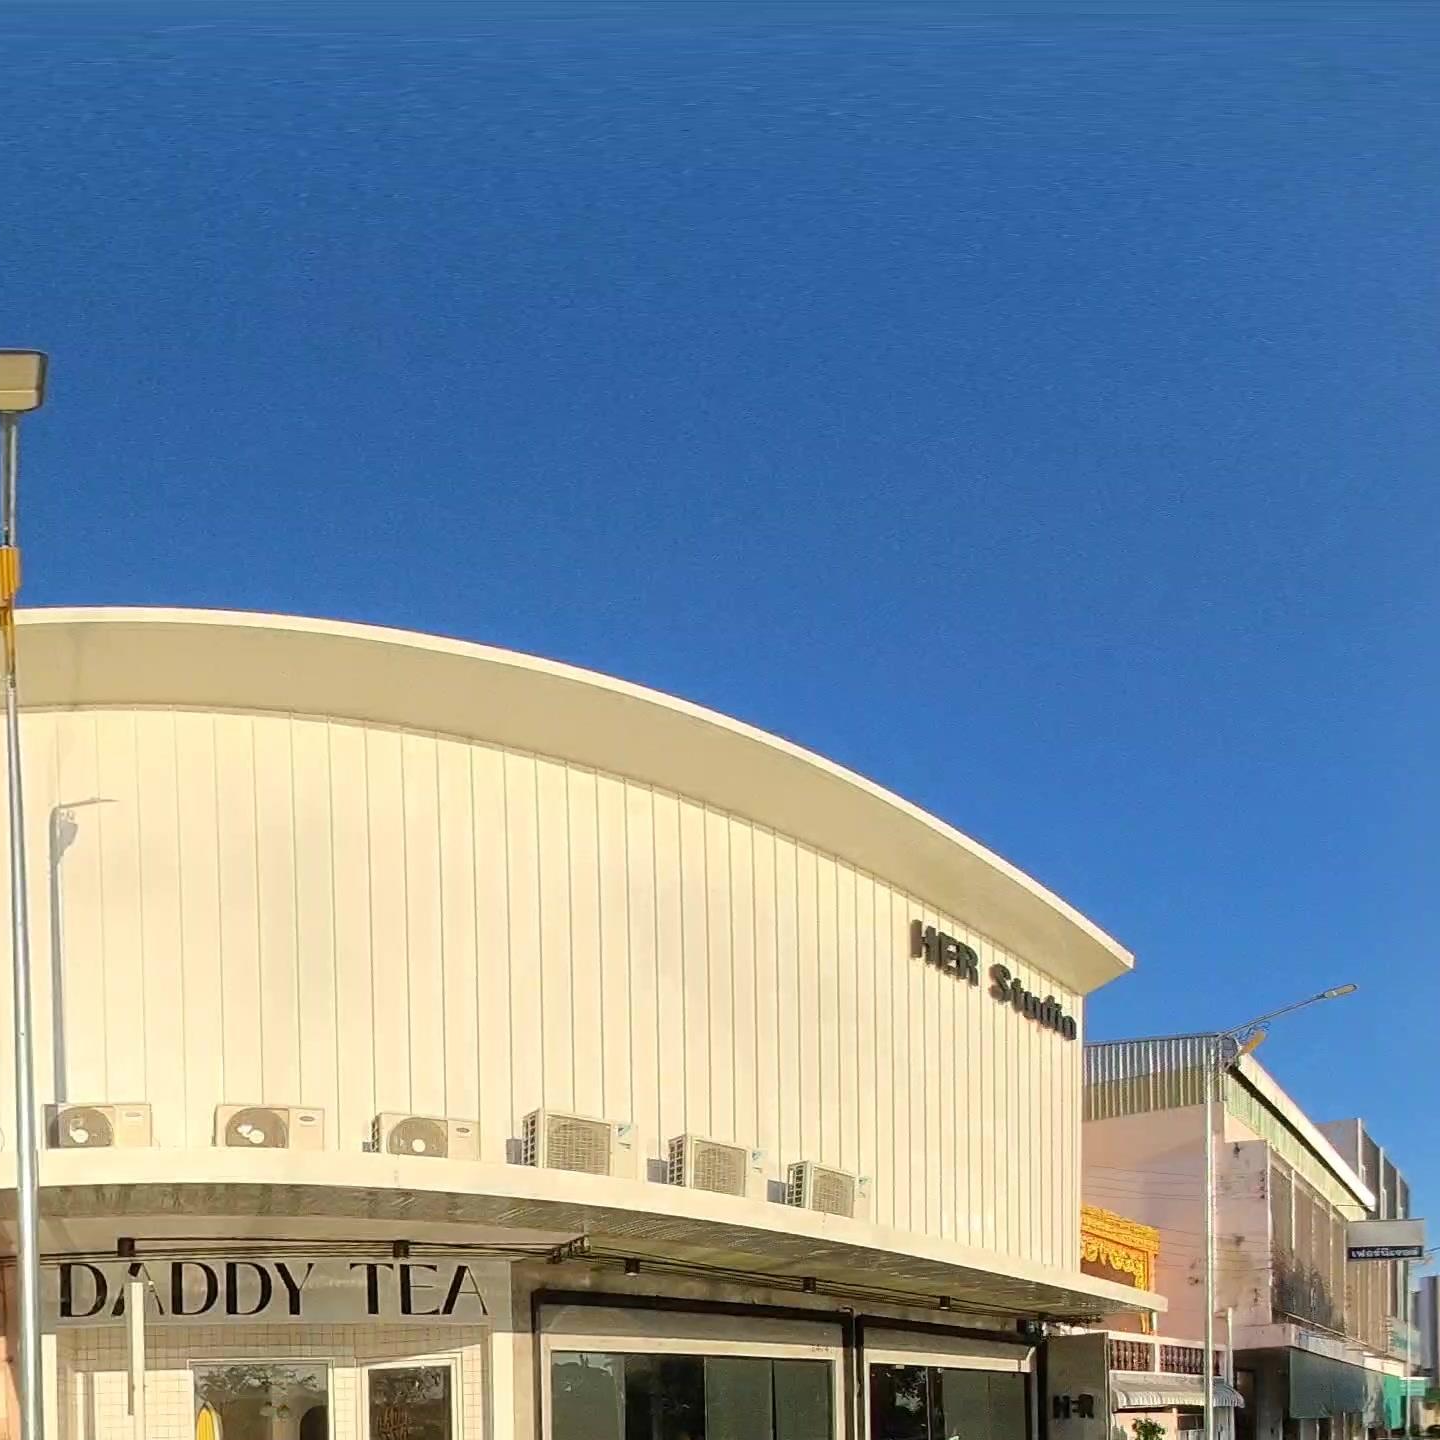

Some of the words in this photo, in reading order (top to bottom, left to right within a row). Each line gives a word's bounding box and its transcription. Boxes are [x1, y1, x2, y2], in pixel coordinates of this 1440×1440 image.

[910, 919, 978, 987] HER
[988, 963, 1077, 1041] Studio
[59, 1262, 315, 1317] DADDY
[350, 1263, 488, 1316] TEA
